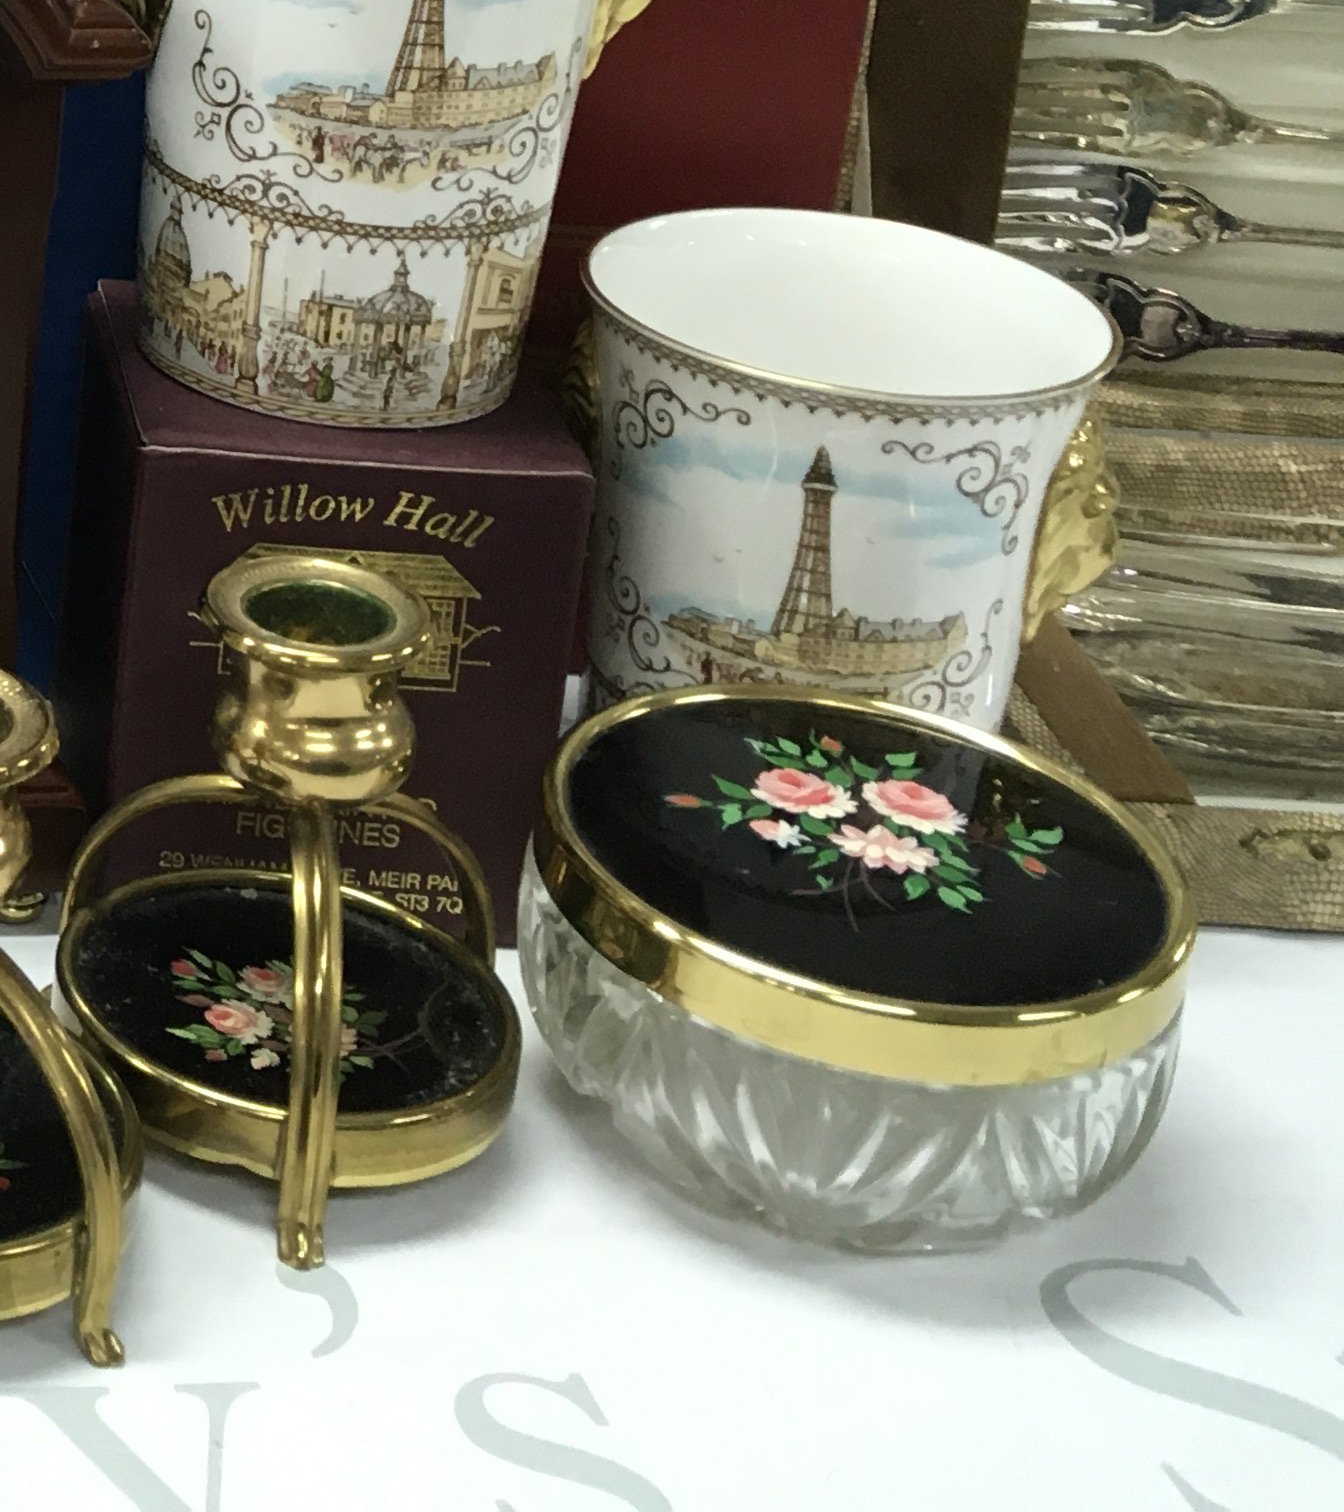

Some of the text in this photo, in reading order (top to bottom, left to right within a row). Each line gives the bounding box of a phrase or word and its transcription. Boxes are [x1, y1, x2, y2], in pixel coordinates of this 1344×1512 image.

[211, 484, 493, 548] Willow Hall
[235, 811, 401, 849] FIGNES
[368, 870, 421, 890] MEIR
[427, 874, 458, 893] PA
